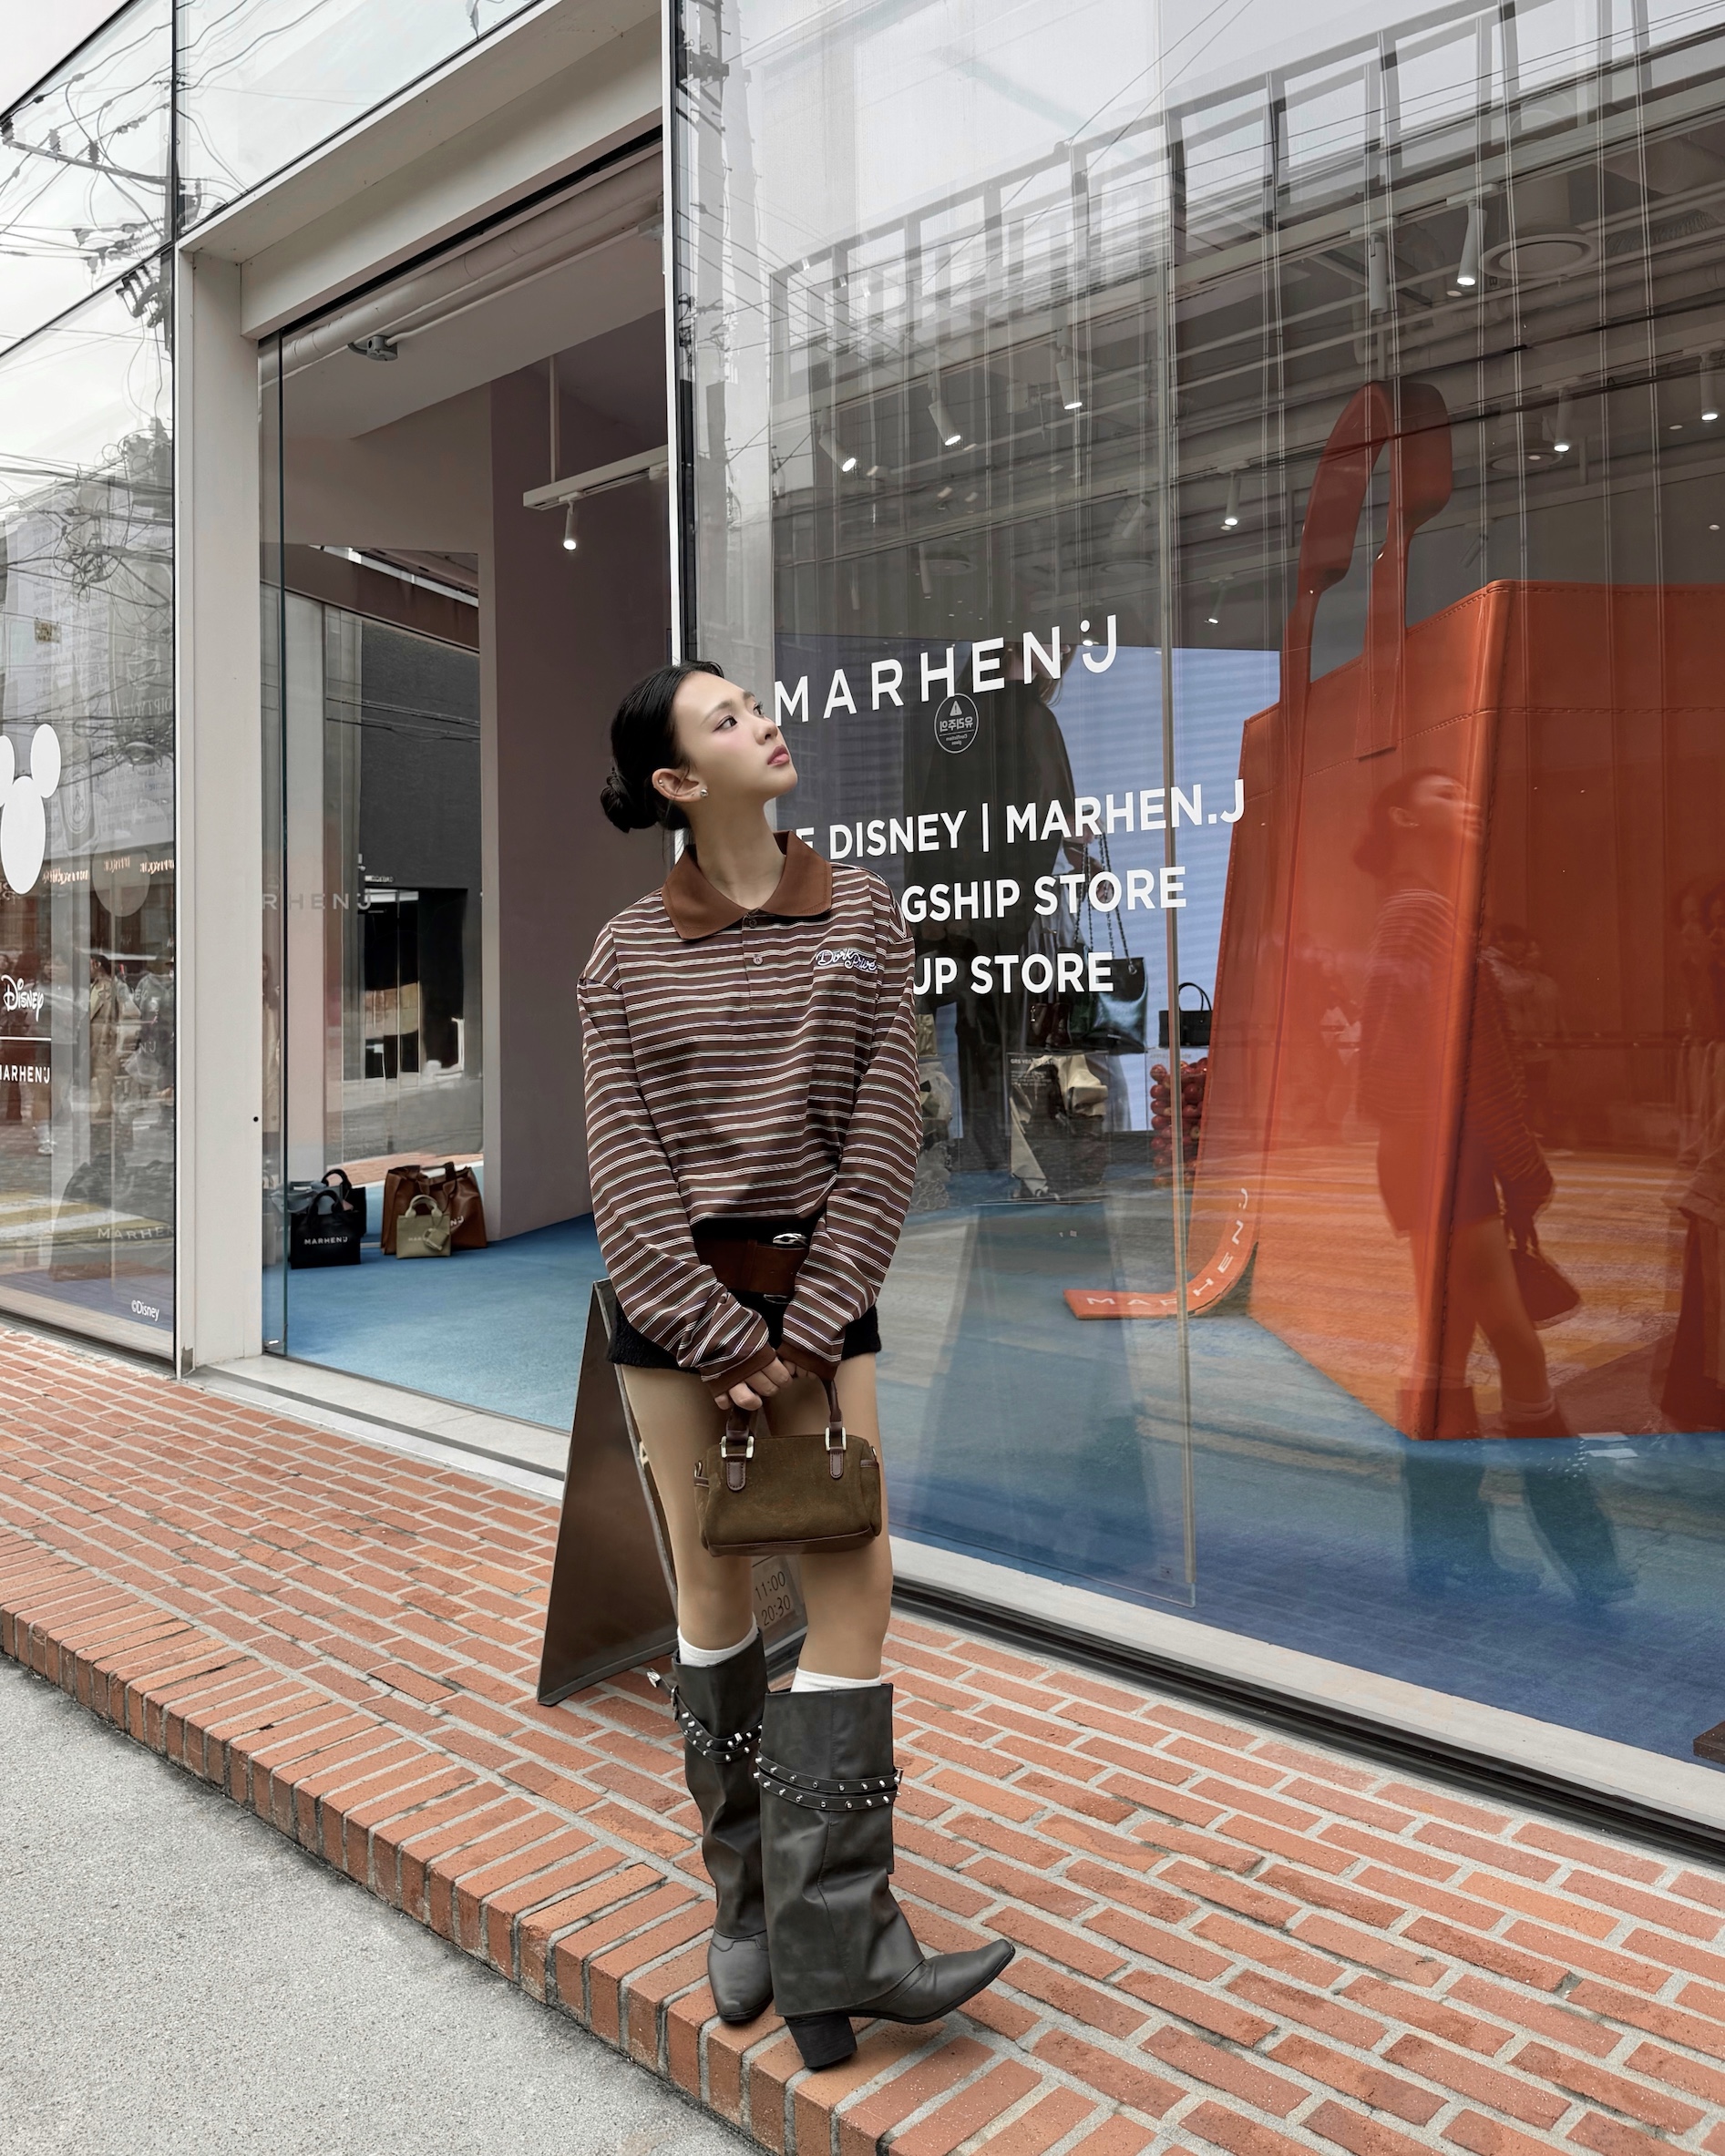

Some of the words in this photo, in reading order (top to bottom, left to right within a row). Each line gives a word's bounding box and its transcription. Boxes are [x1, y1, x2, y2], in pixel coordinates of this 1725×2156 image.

[829, 810, 968, 860] DISNEY
[1006, 778, 1245, 844] MARHEN.J
[900, 878, 1021, 923] GSHIP
[1033, 866, 1186, 916] STORE
[970, 951, 1114, 995] STORE
[755, 1571, 785, 1601] 11:00
[761, 1595, 791, 1626] 20:30
